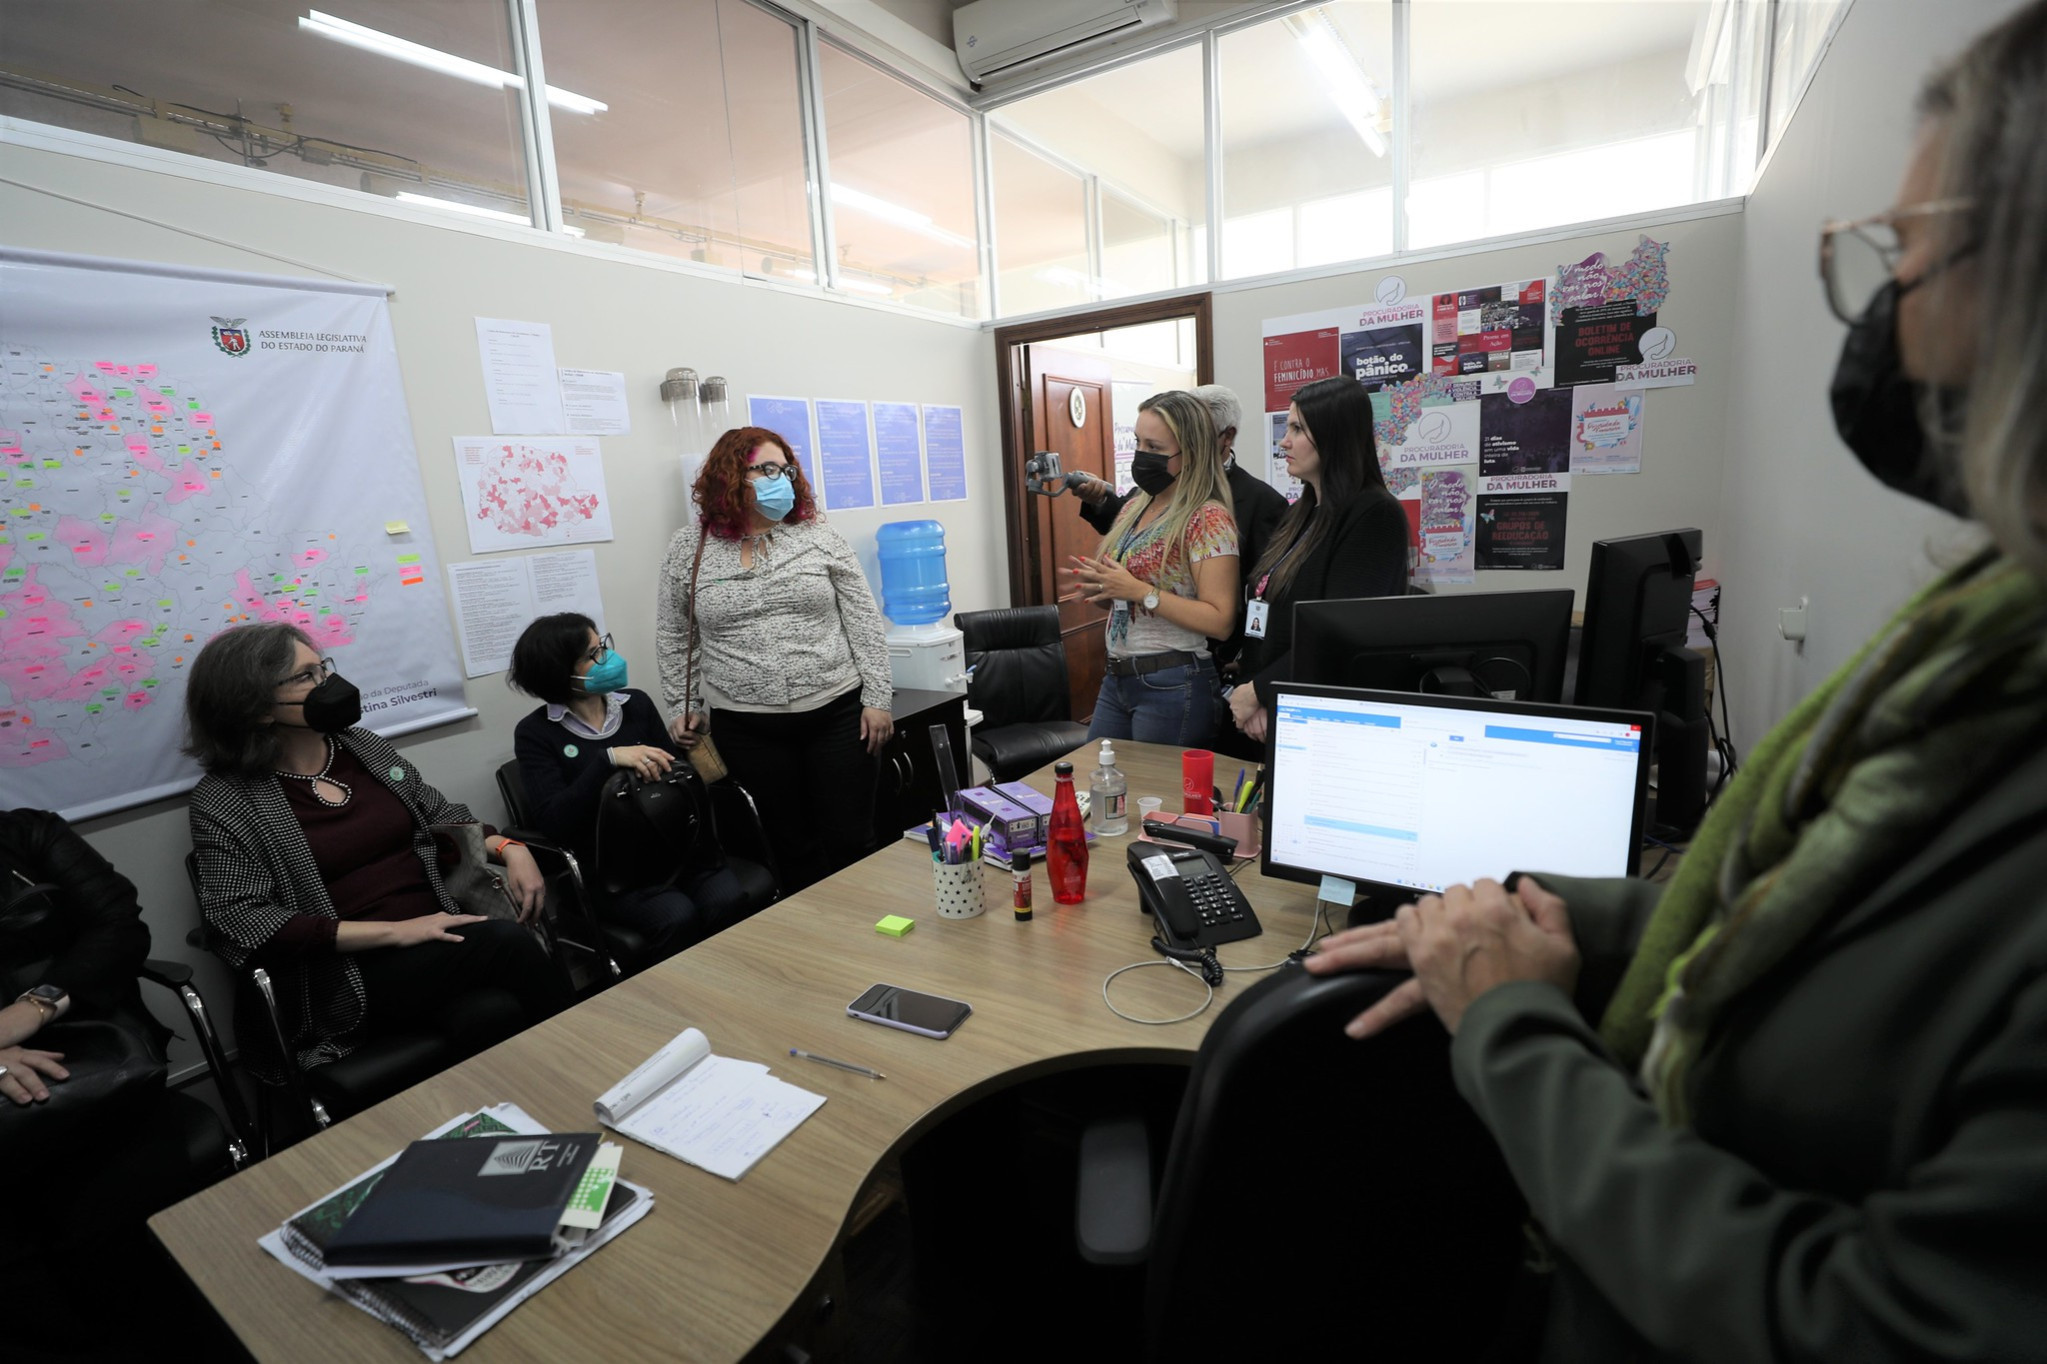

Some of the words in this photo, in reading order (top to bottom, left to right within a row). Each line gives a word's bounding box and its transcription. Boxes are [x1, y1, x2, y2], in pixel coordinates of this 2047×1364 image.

[1574, 259, 1604, 273] medo
[1583, 281, 1603, 290] nos
[1363, 303, 1419, 317] PROCURADORIA
[1359, 318, 1375, 327] DA
[1377, 310, 1424, 325] MULHER
[259, 330, 314, 341] ASSEMBLEIA
[316, 333, 367, 343] LEGISLATIVA
[1578, 325, 1617, 338] BOLETIM
[1620, 322, 1632, 333] DE
[261, 341, 276, 350] DO
[278, 342, 314, 352] ESTADO
[316, 343, 329, 352] DO
[331, 343, 365, 353] PARANÁ
[1588, 345, 1621, 356] ONLINE
[1280, 358, 1304, 371] CONTRA
[1356, 355, 1386, 367] botão
[1389, 353, 1403, 362] do
[1621, 359, 1692, 372] PROCURADORIA
[1355, 361, 1409, 381] pânico
[1616, 372, 1635, 382] DA
[1638, 366, 1698, 380] MULHER
[1404, 443, 1465, 453] PROCURADORIA
[1400, 453, 1416, 463] DA
[1419, 450, 1468, 462] MULHER
[1490, 473, 1553, 482] PROCURADORIA
[1487, 482, 1503, 491] DA
[1506, 480, 1557, 490] MULHER
[370, 690, 382, 698] da
[383, 679, 429, 695] Deputada
[360, 701, 388, 714] stina
[390, 688, 437, 707] Silvestri
[528, 1140, 560, 1172] RT
